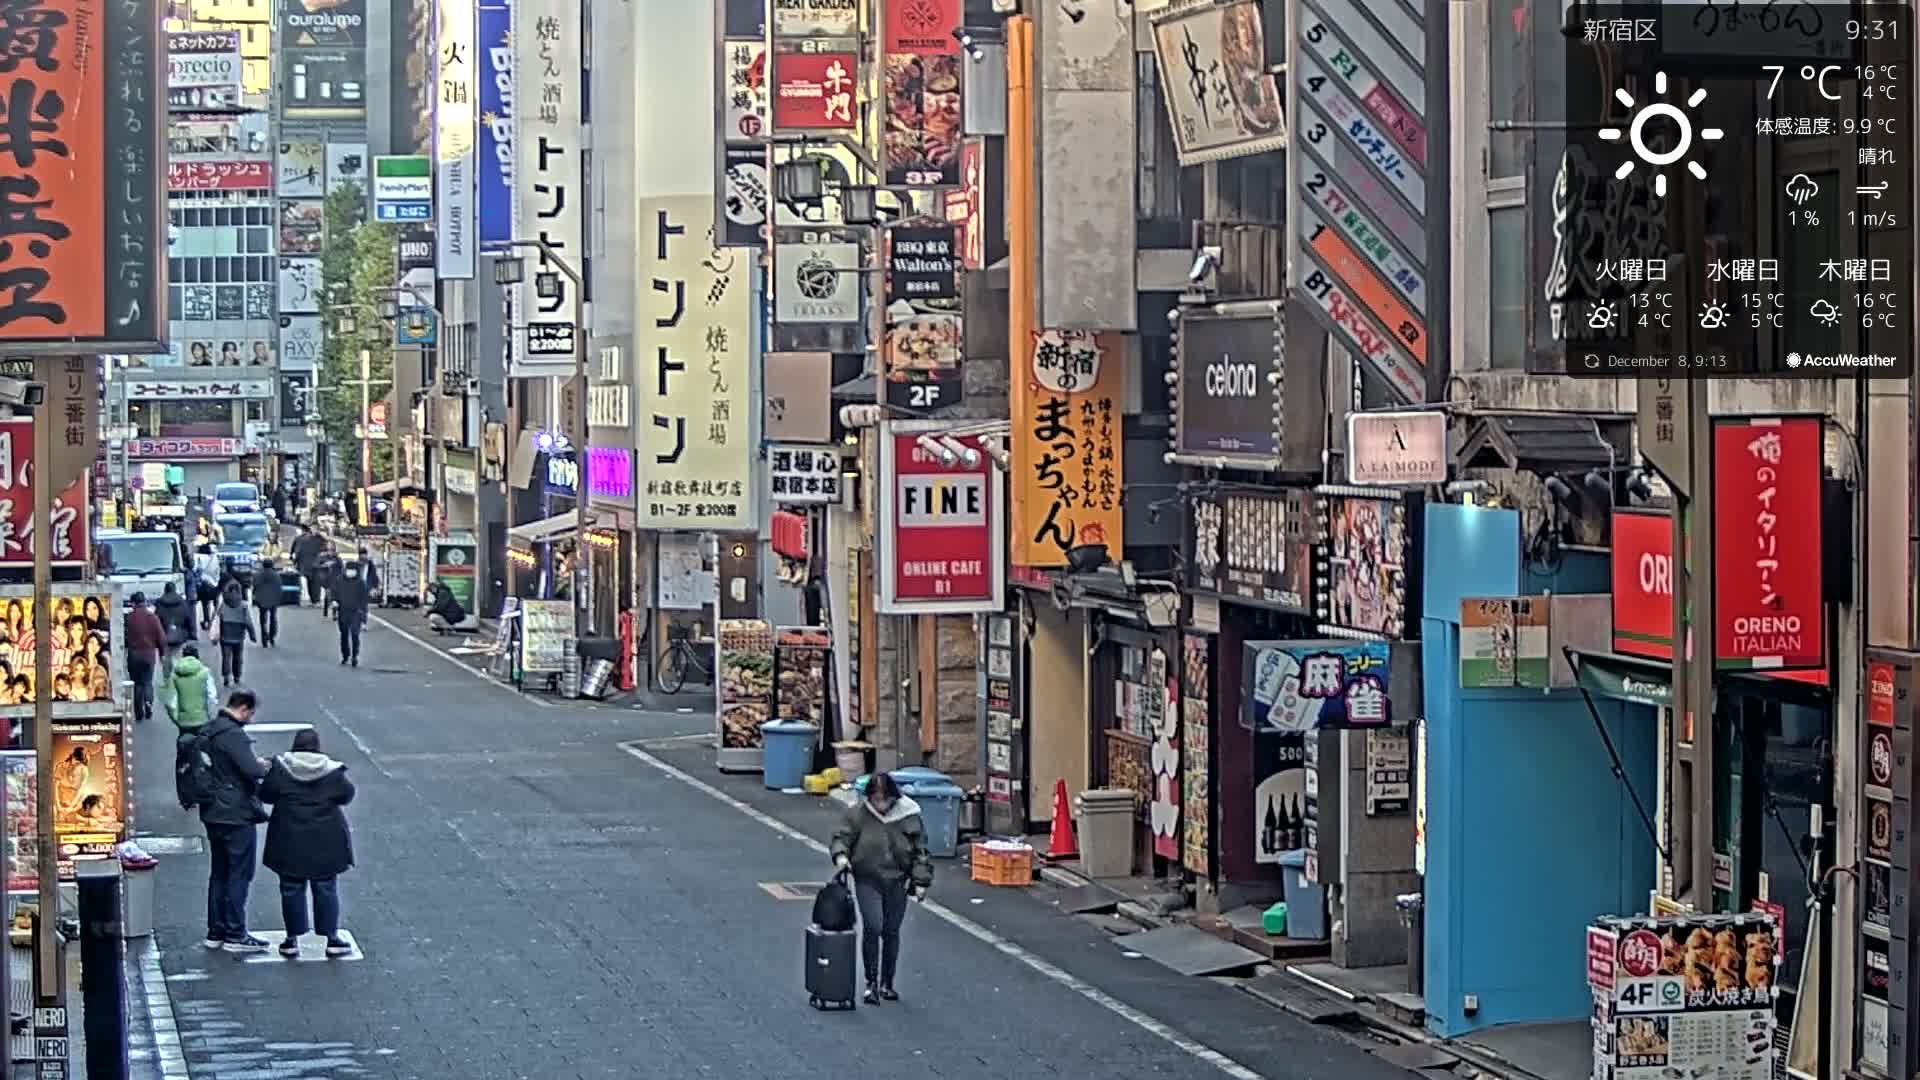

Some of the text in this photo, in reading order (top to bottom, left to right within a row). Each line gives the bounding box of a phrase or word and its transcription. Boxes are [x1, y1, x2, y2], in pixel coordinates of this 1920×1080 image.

[808, 0, 856, 10] GARDEN
[1307, 74, 1327, 93] 4
[1307, 122, 1327, 144] 3
[379, 183, 430, 196] FamilyMart
[1306, 173, 1328, 195] 2
[893, 255, 954, 273] Walton's
[1305, 270, 1332, 301] B1
[653, 209, 687, 465] トントン
[1205, 353, 1257, 398] celona
[909, 386, 942, 406] 2F
[773, 450, 839, 474] 酒場心
[1034, 396, 1079, 550] まっちゃん
[773, 474, 839, 496] 新宿本店
[904, 483, 981, 516] FINE
[1748, 432, 1783, 608] 俺のイタリアン
[903, 560, 984, 578] ONLINE CAFE
[1640, 553, 1673, 604] OR
[1734, 616, 1801, 635] ORENO
[1733, 635, 1802, 655] ITALIAN
[1619, 982, 1654, 1006] 4F
[35, 1007, 65, 1028] NERO
[38, 1039, 68, 1058] NERO
